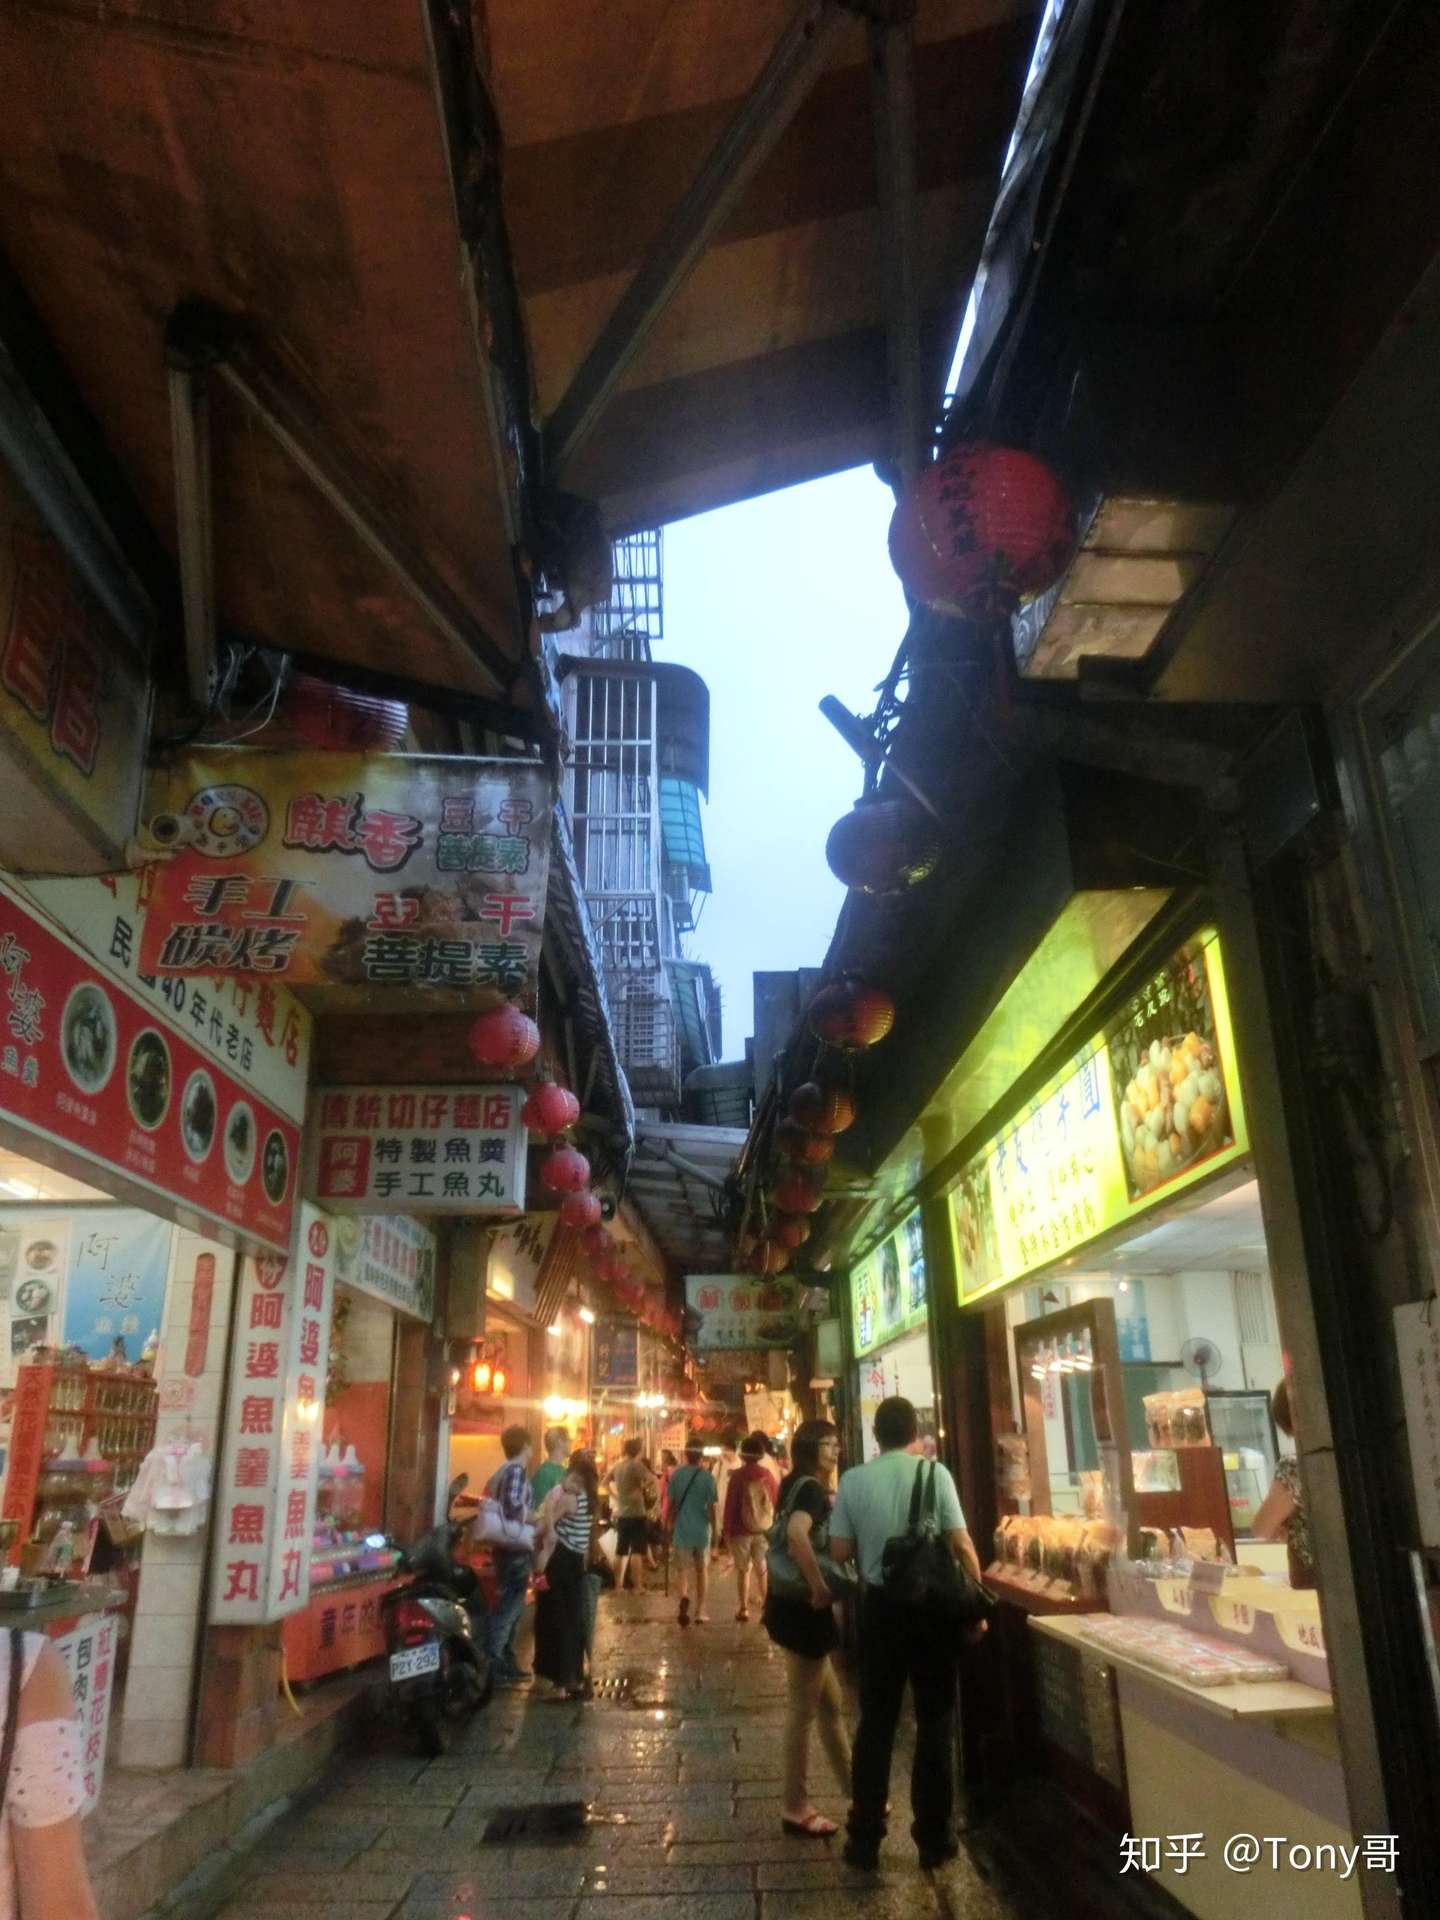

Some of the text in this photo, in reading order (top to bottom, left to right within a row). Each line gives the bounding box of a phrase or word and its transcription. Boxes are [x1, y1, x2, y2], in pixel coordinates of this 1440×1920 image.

[184, 875, 316, 920] 手工
[159, 923, 302, 973] 碳烤
[363, 935, 529, 985] 菩提素
[373, 1171, 505, 1198] 手工魚丸
